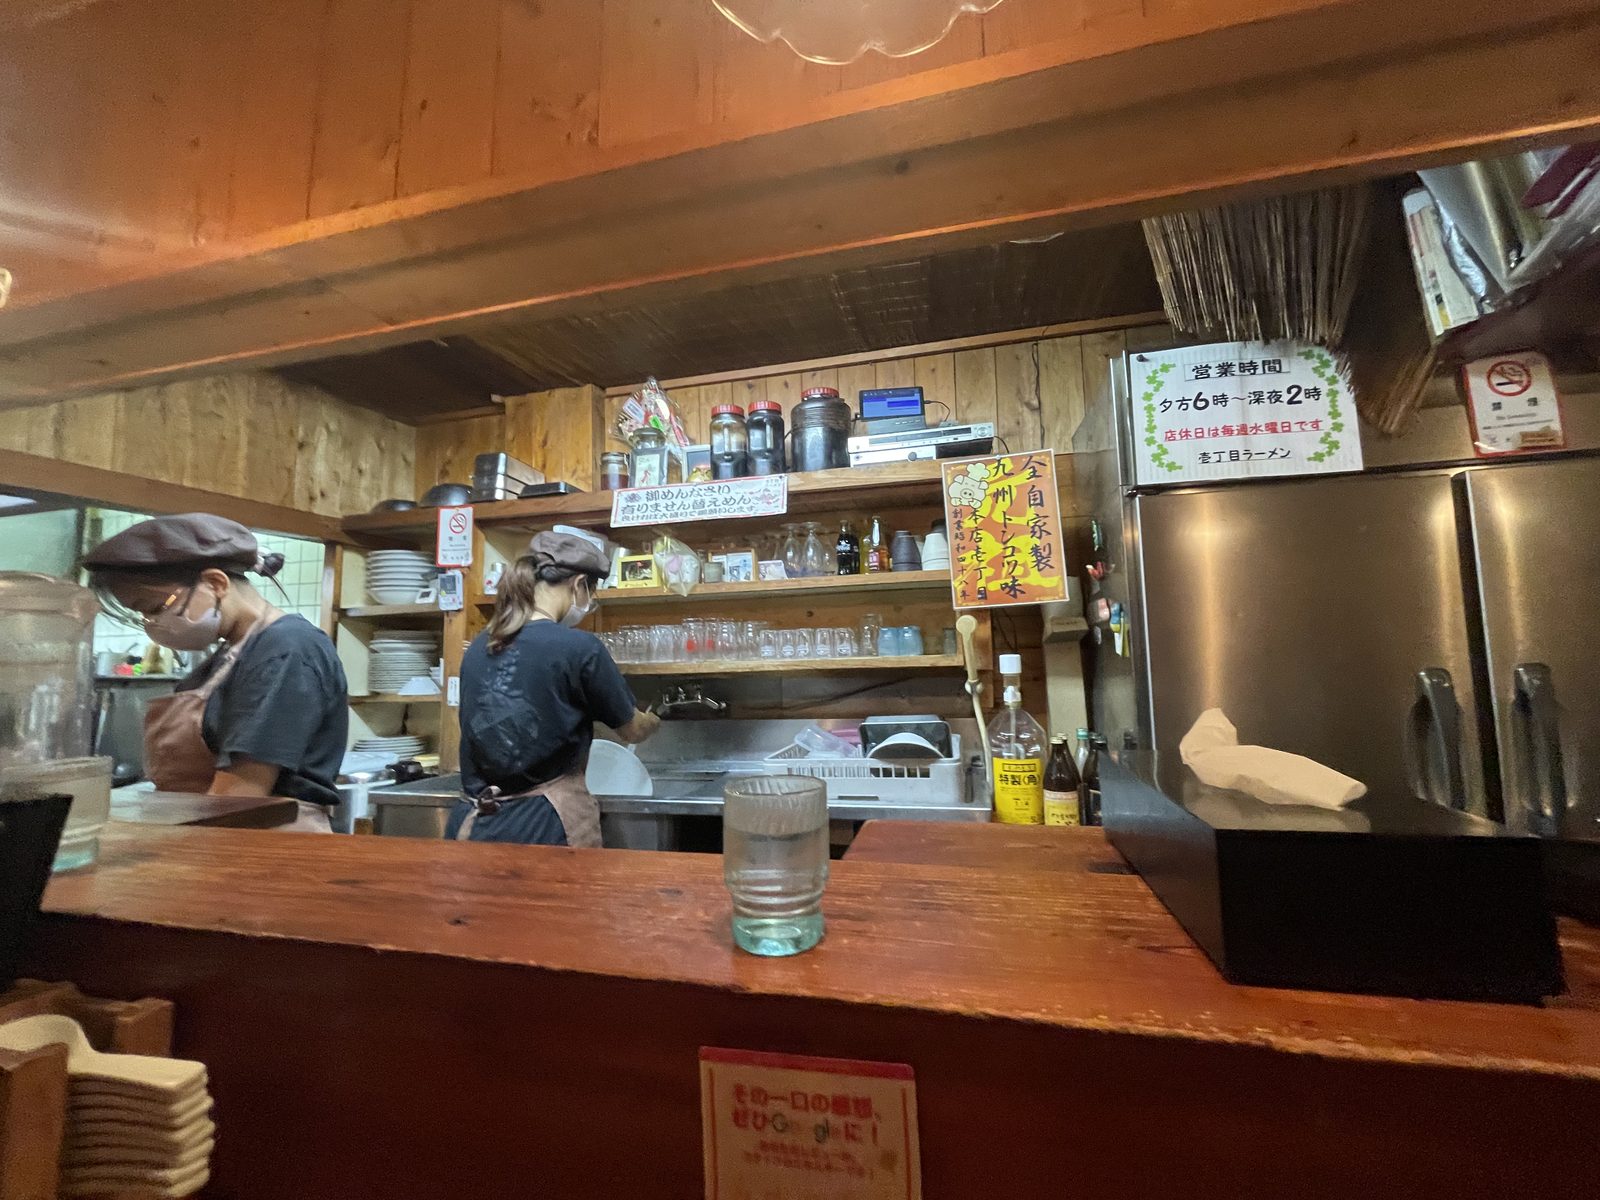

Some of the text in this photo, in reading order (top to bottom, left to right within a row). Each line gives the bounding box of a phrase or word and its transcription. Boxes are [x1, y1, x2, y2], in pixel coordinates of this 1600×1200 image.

[1192, 358, 1283, 380] 営業時間
[1164, 419, 1323, 442] 店休日は毎週水曜日です
[1198, 447, 1292, 464] 壱丁目ラーメン
[1020, 455, 1055, 572] 全自家製
[992, 459, 1026, 599] 九州トンコツ味
